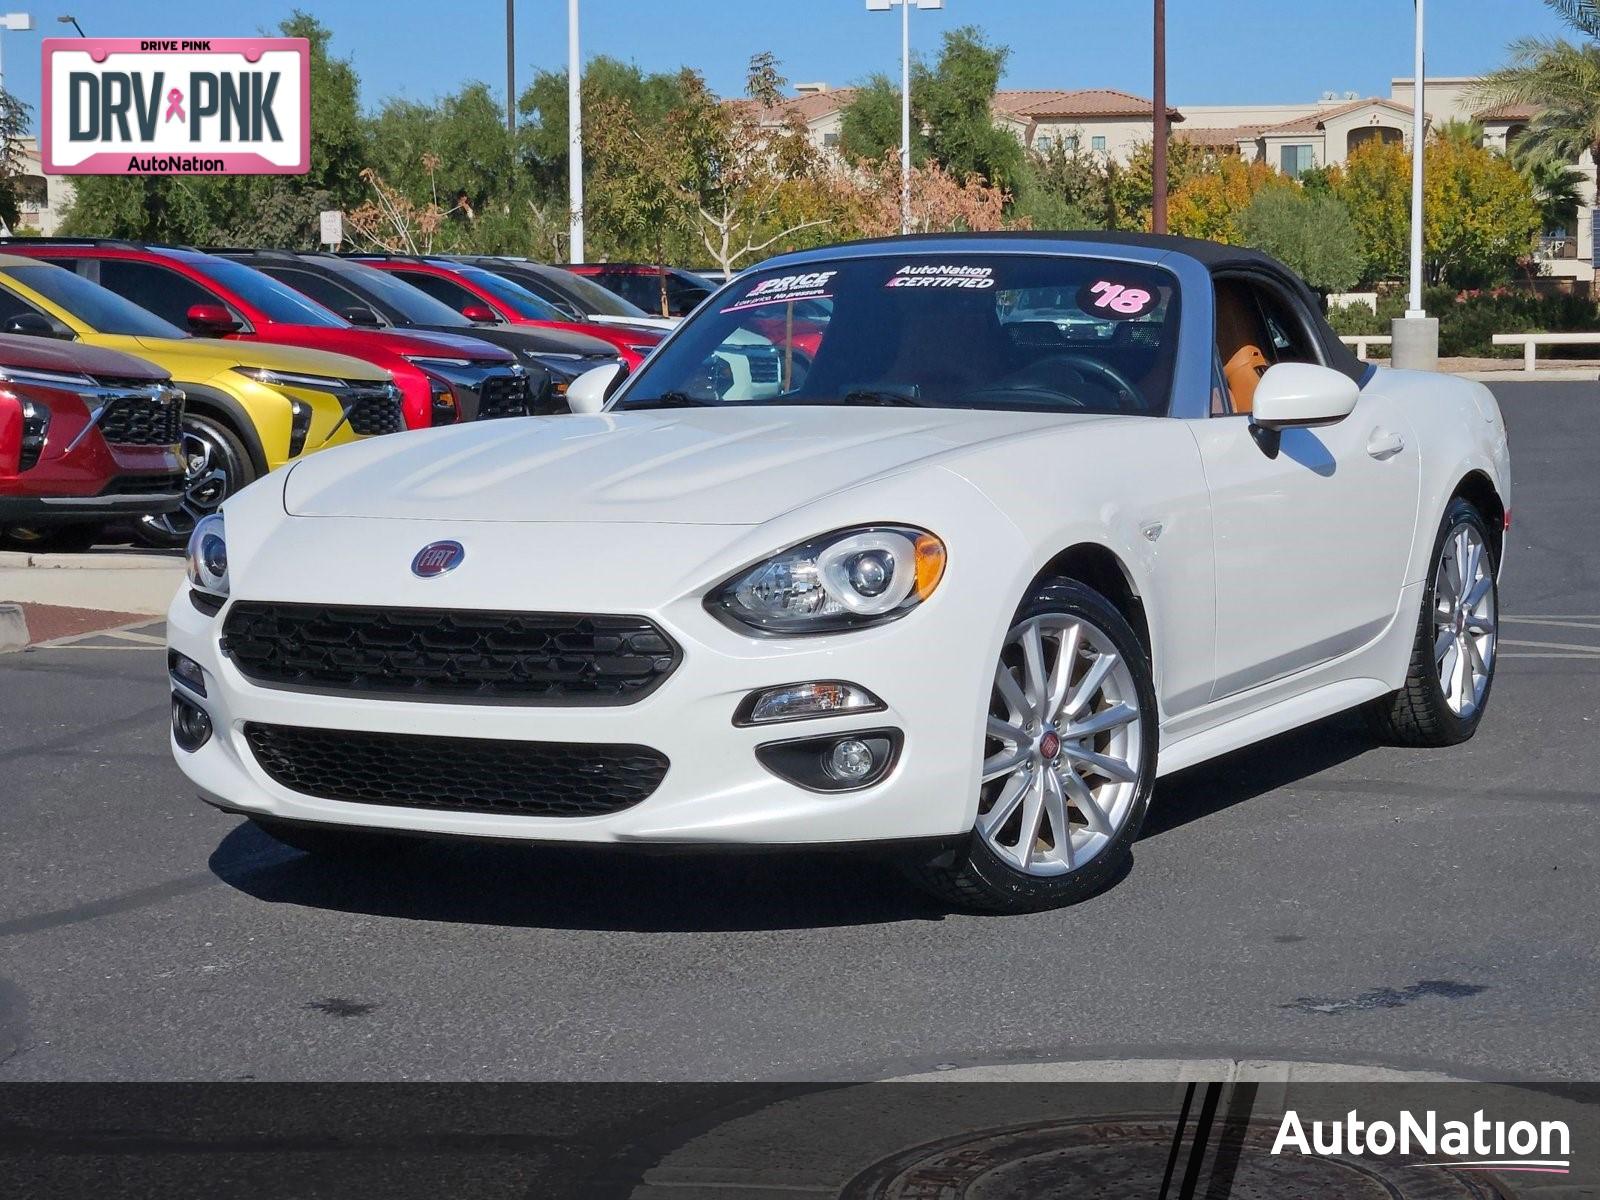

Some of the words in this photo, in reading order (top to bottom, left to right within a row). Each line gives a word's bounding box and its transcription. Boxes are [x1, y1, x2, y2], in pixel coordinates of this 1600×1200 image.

[896, 265, 993, 275] AutoNation
[894, 276, 995, 289] CERTIFIED
[420, 550, 456, 567] FIAT
